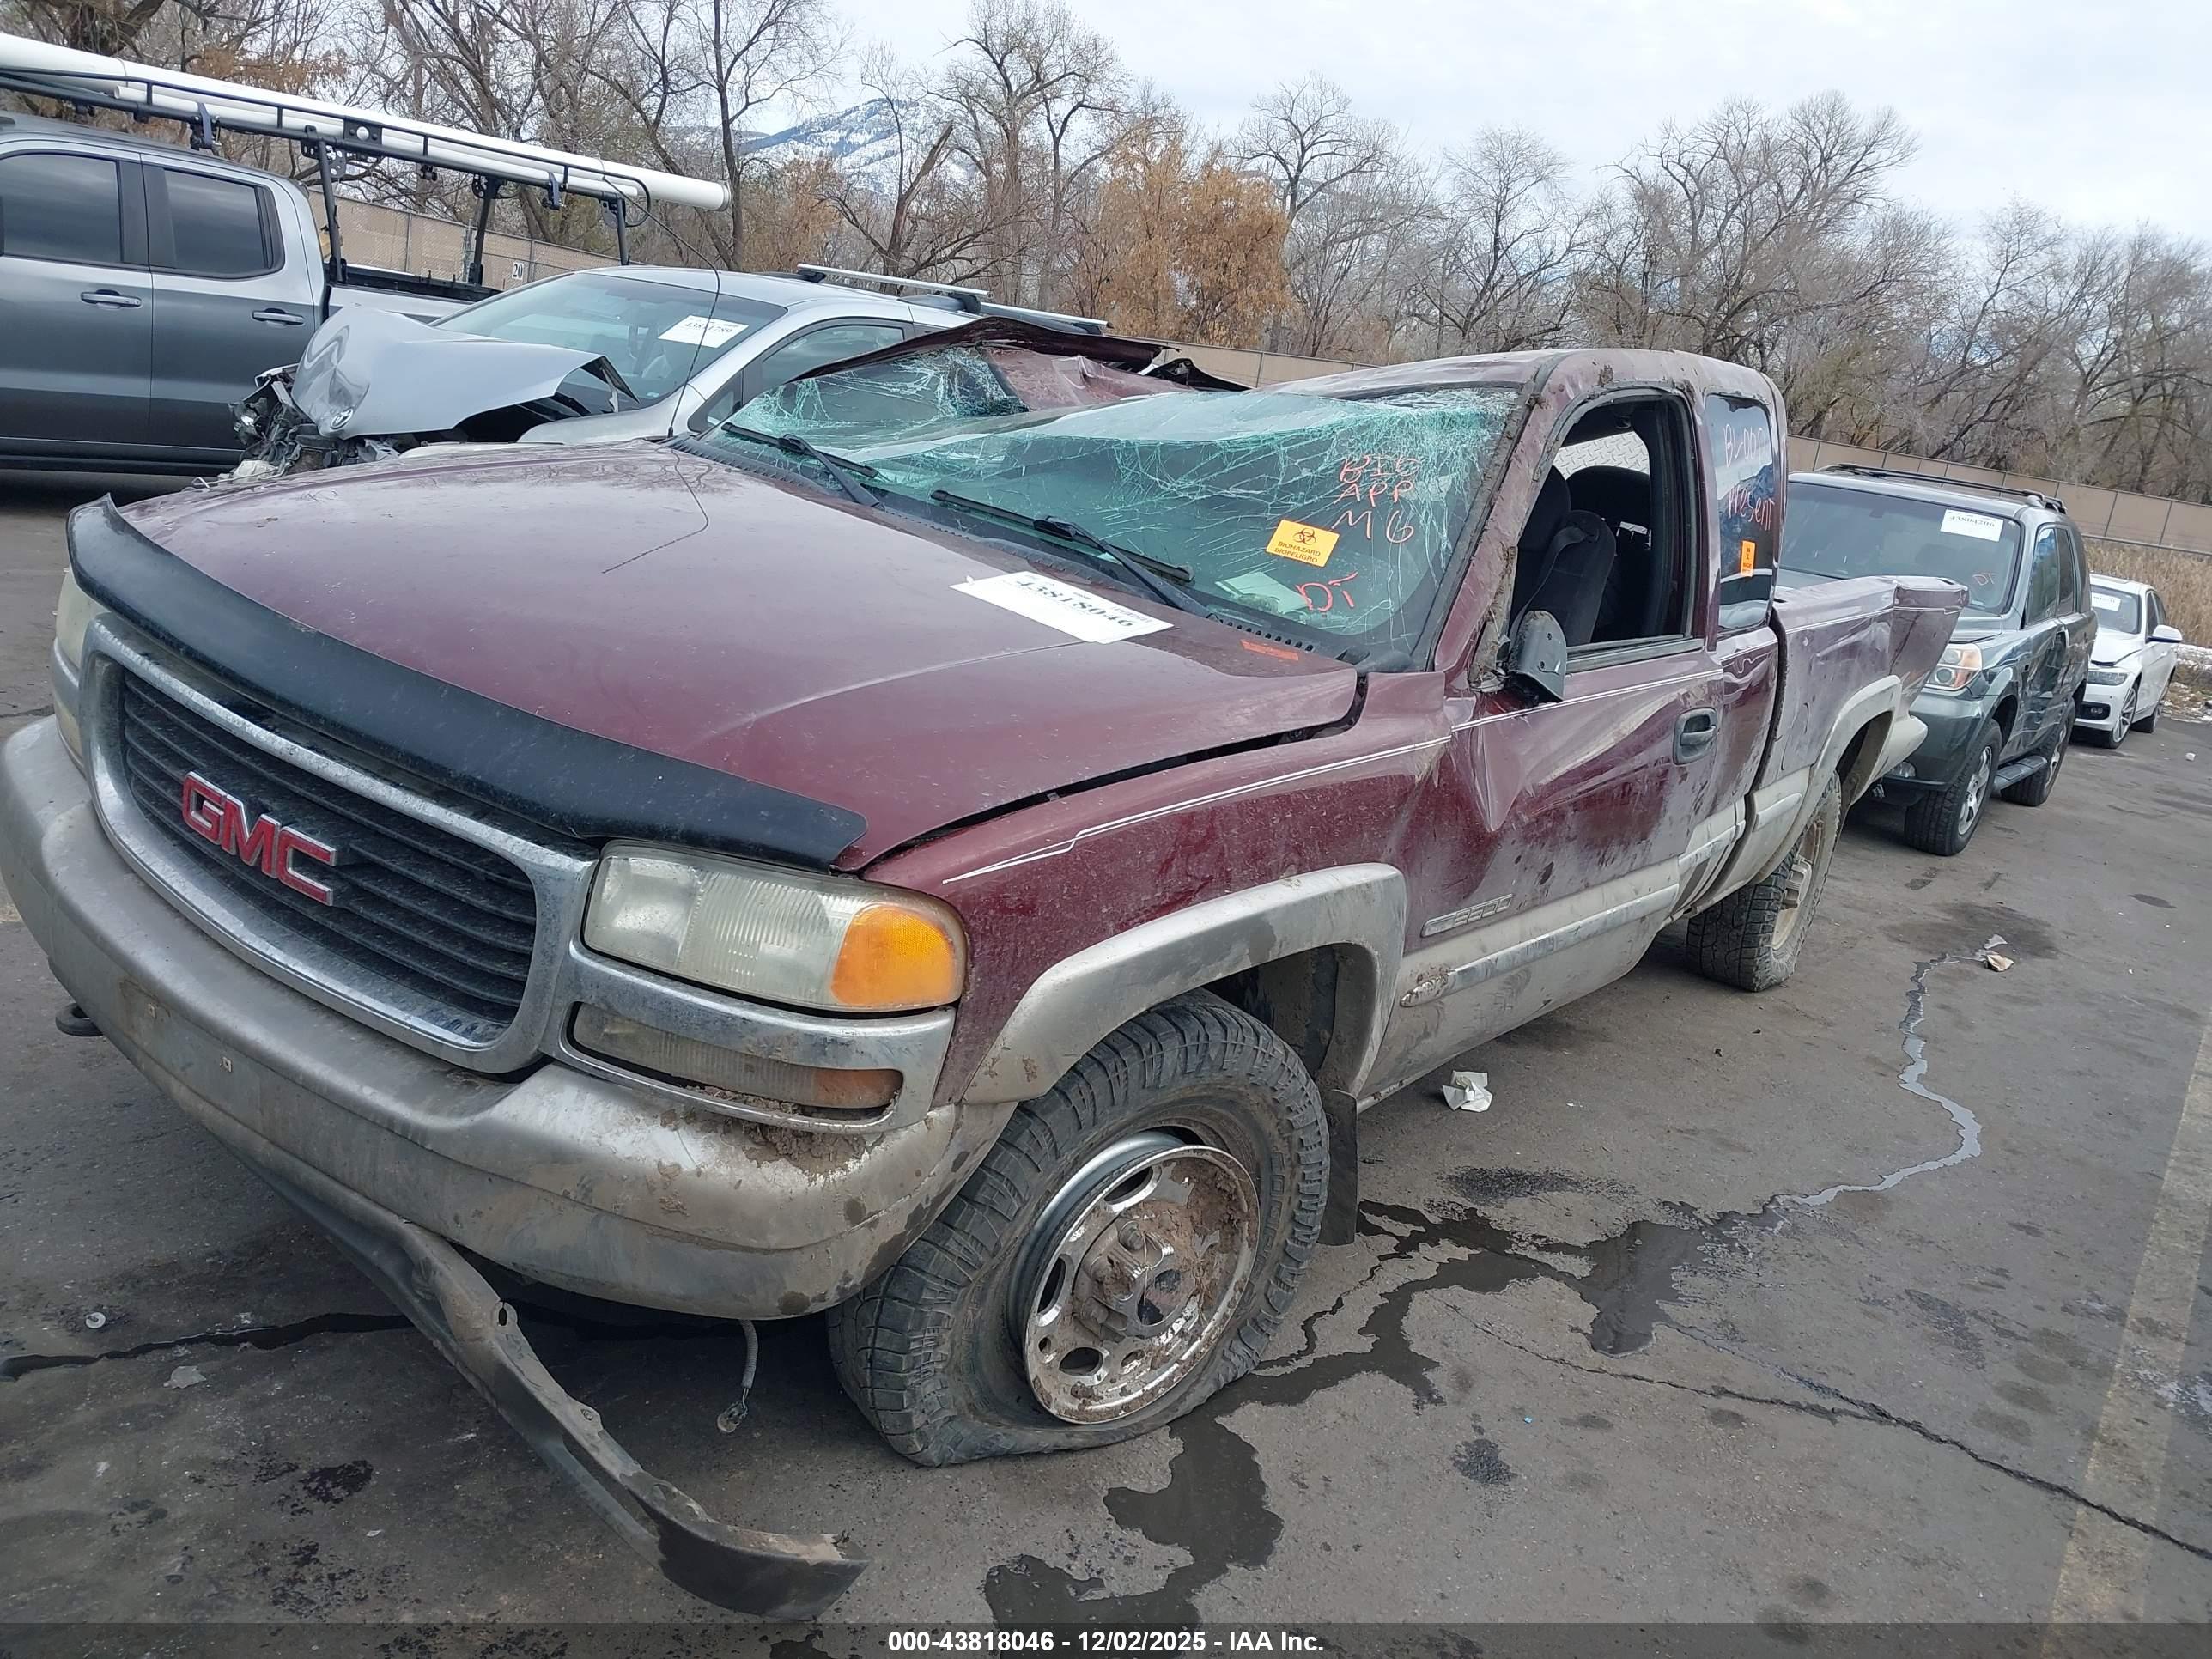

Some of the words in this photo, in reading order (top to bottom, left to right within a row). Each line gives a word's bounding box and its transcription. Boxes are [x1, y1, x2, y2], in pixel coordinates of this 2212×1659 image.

[512, 263, 523, 278] 20
[1334, 480, 1413, 507] APP
[1273, 547, 1319, 563] BIOPELIGRO
[1277, 541, 1322, 557] BIOHAZARD
[1017, 580, 1133, 627] 43818046
[182, 771, 336, 906] GMC
